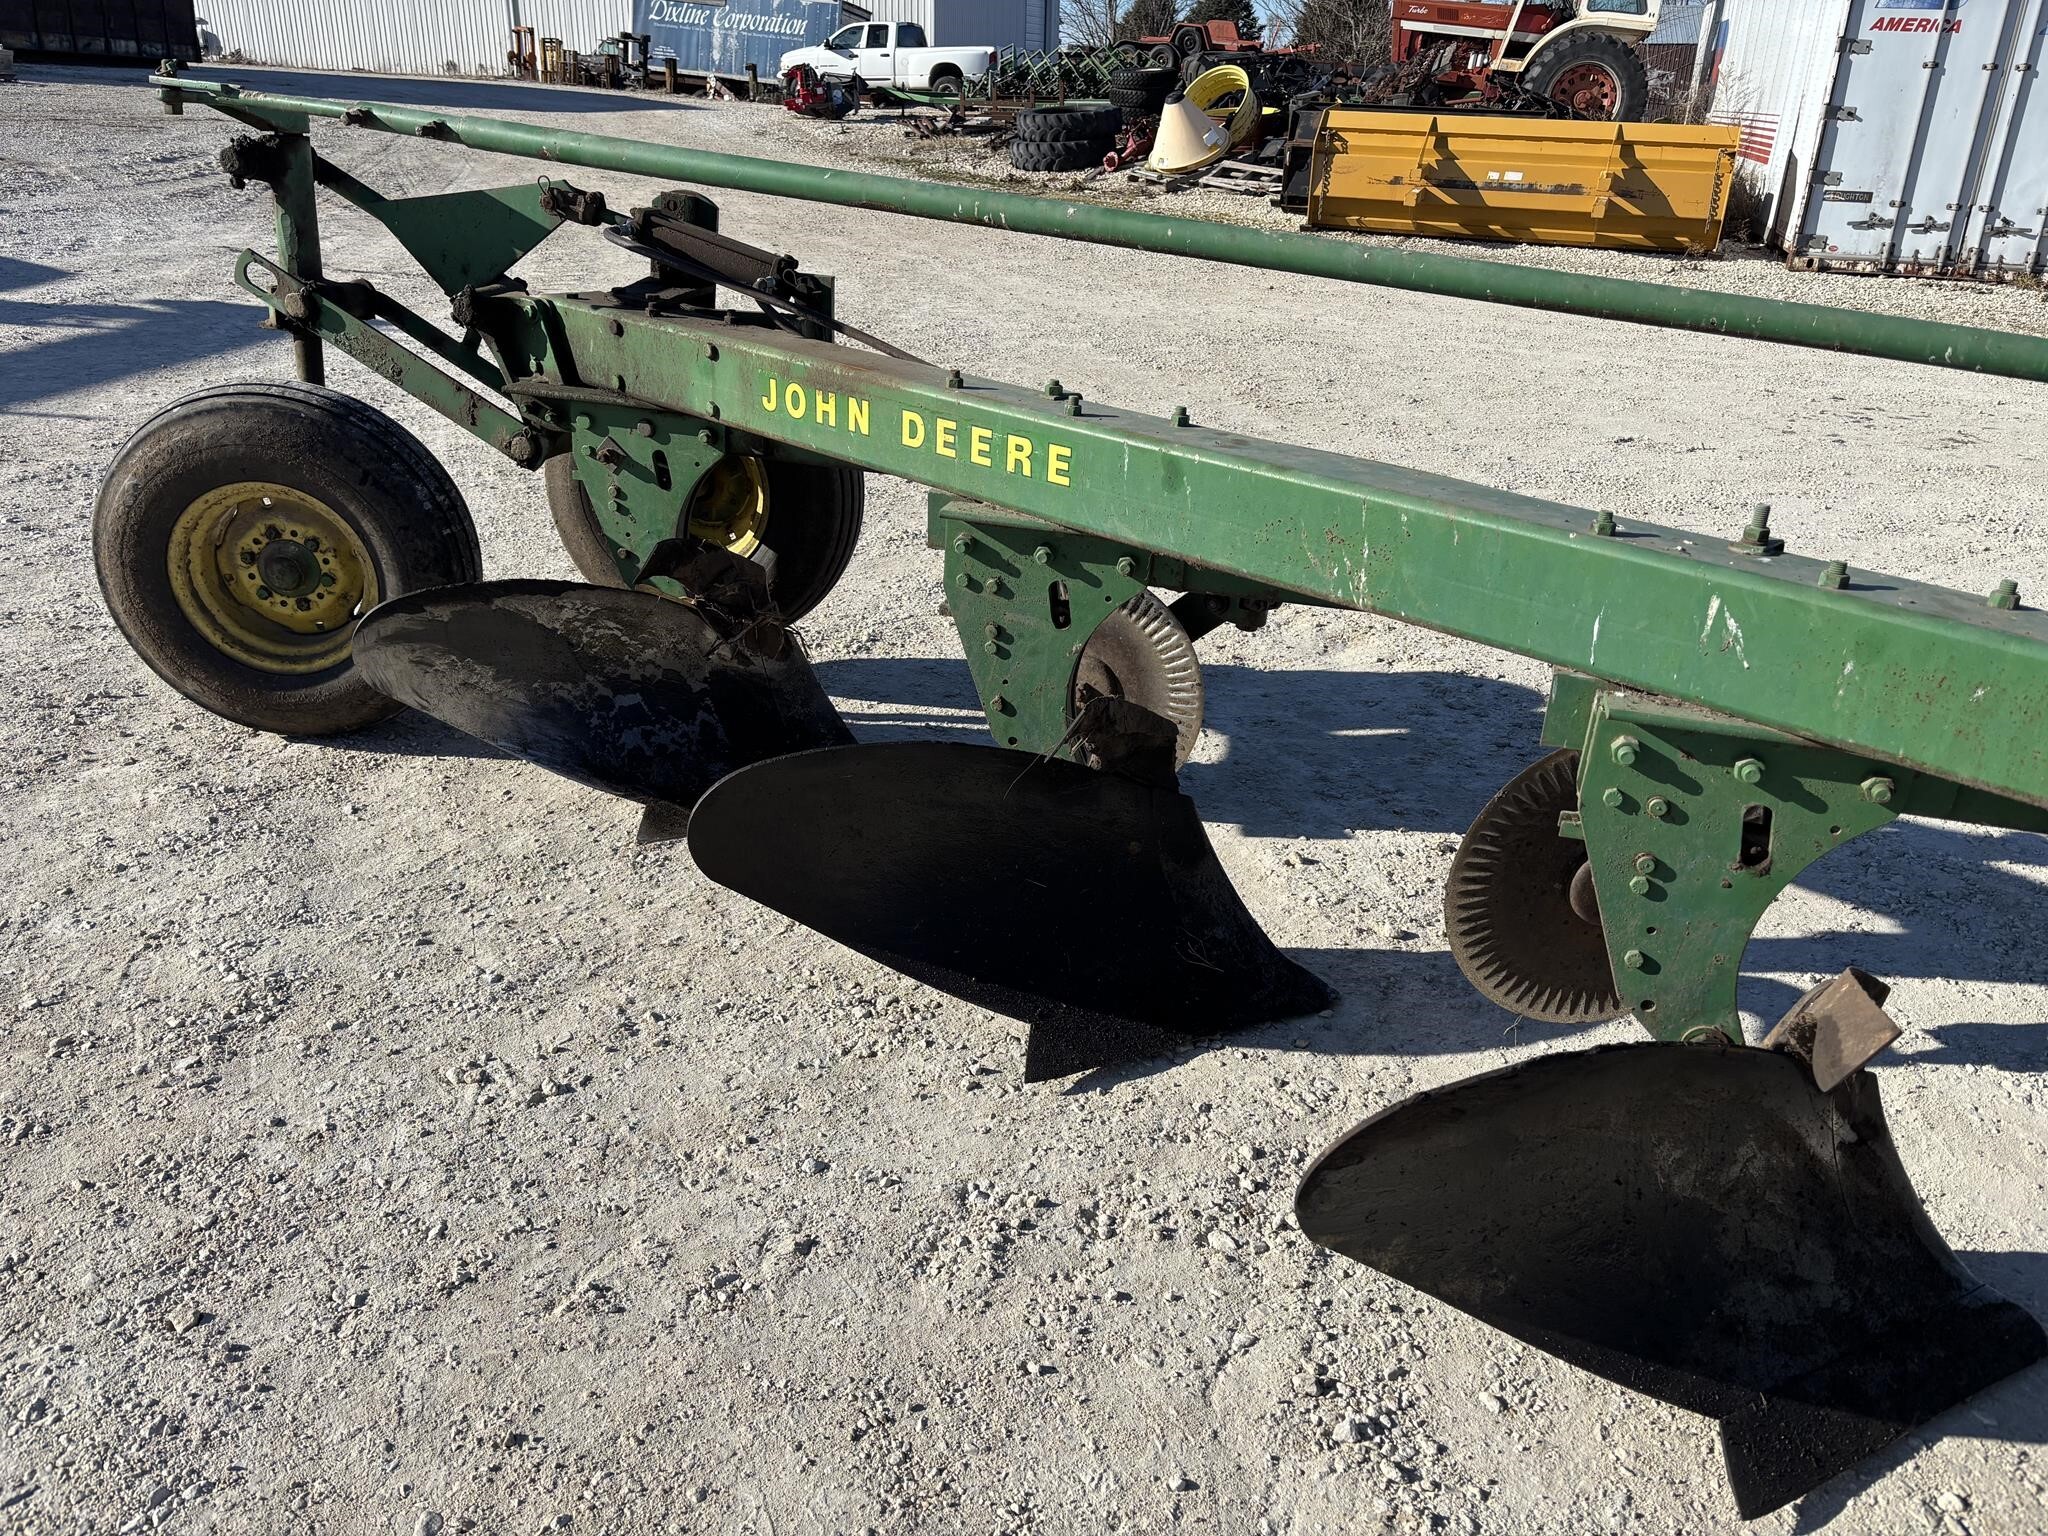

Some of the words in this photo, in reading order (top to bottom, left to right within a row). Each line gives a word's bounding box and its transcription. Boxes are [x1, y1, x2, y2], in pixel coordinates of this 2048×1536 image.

[648, 0, 710, 25] Dixline
[712, 5, 808, 35] Corporation
[1408, 4, 1429, 14] Turbo
[1869, 16, 1963, 34] AMERICA
[761, 378, 870, 436] JOHN
[901, 409, 1072, 487] DEERE
